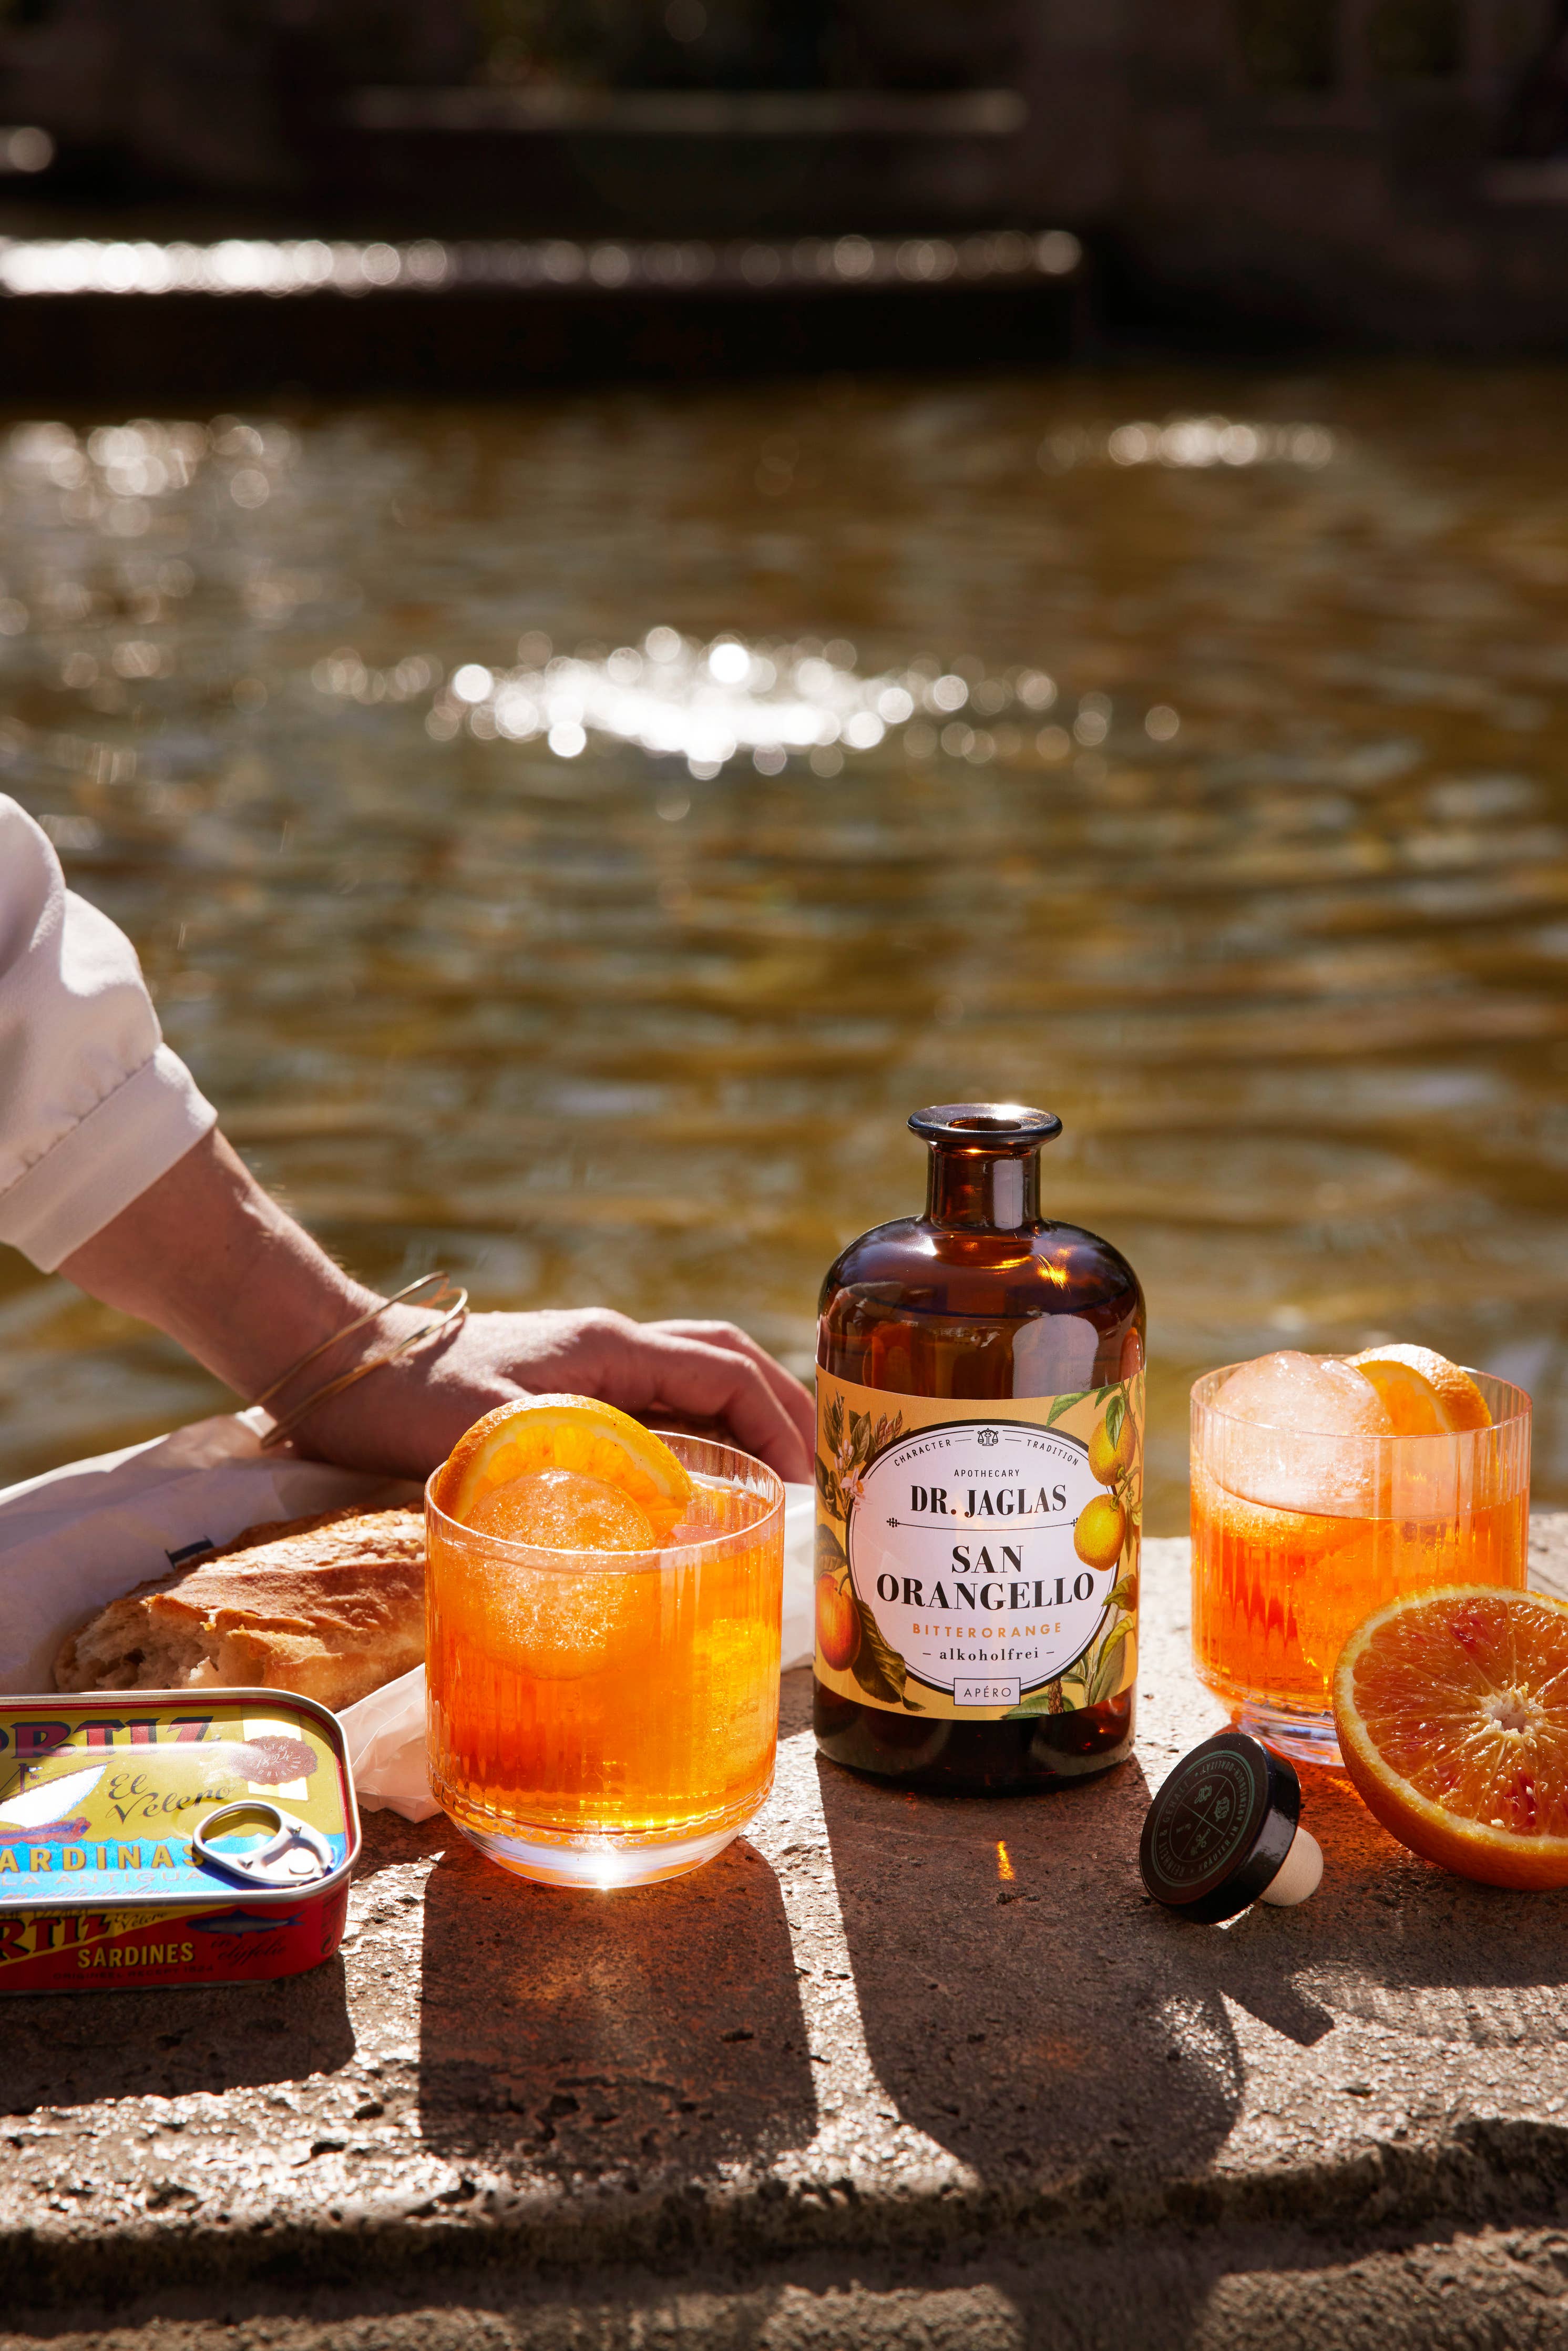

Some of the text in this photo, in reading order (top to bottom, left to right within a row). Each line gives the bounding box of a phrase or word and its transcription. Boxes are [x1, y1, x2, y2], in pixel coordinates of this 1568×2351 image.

[894, 1439, 1079, 1466] CHARACTER TRADITION
[954, 1469, 1020, 1478] APOTHECARY
[910, 1485, 1067, 1518] DR. JAGLAS
[952, 1546, 1024, 1573] SAN
[877, 1572, 1094, 1610] ORANGELLO
[913, 1622, 1061, 1638] BITTERORANGE
[940, 1647, 1039, 1661] alkoholfrei
[964, 1685, 1011, 1698] APÉRO
[0, 1716, 221, 1759] RTIZ
[108, 1773, 148, 1800] El
[1163, 1781, 1190, 1823] GEHALT
[2, 1871, 204, 1886] LA ANTIGUA
[77, 1943, 196, 1969] SARDINES
